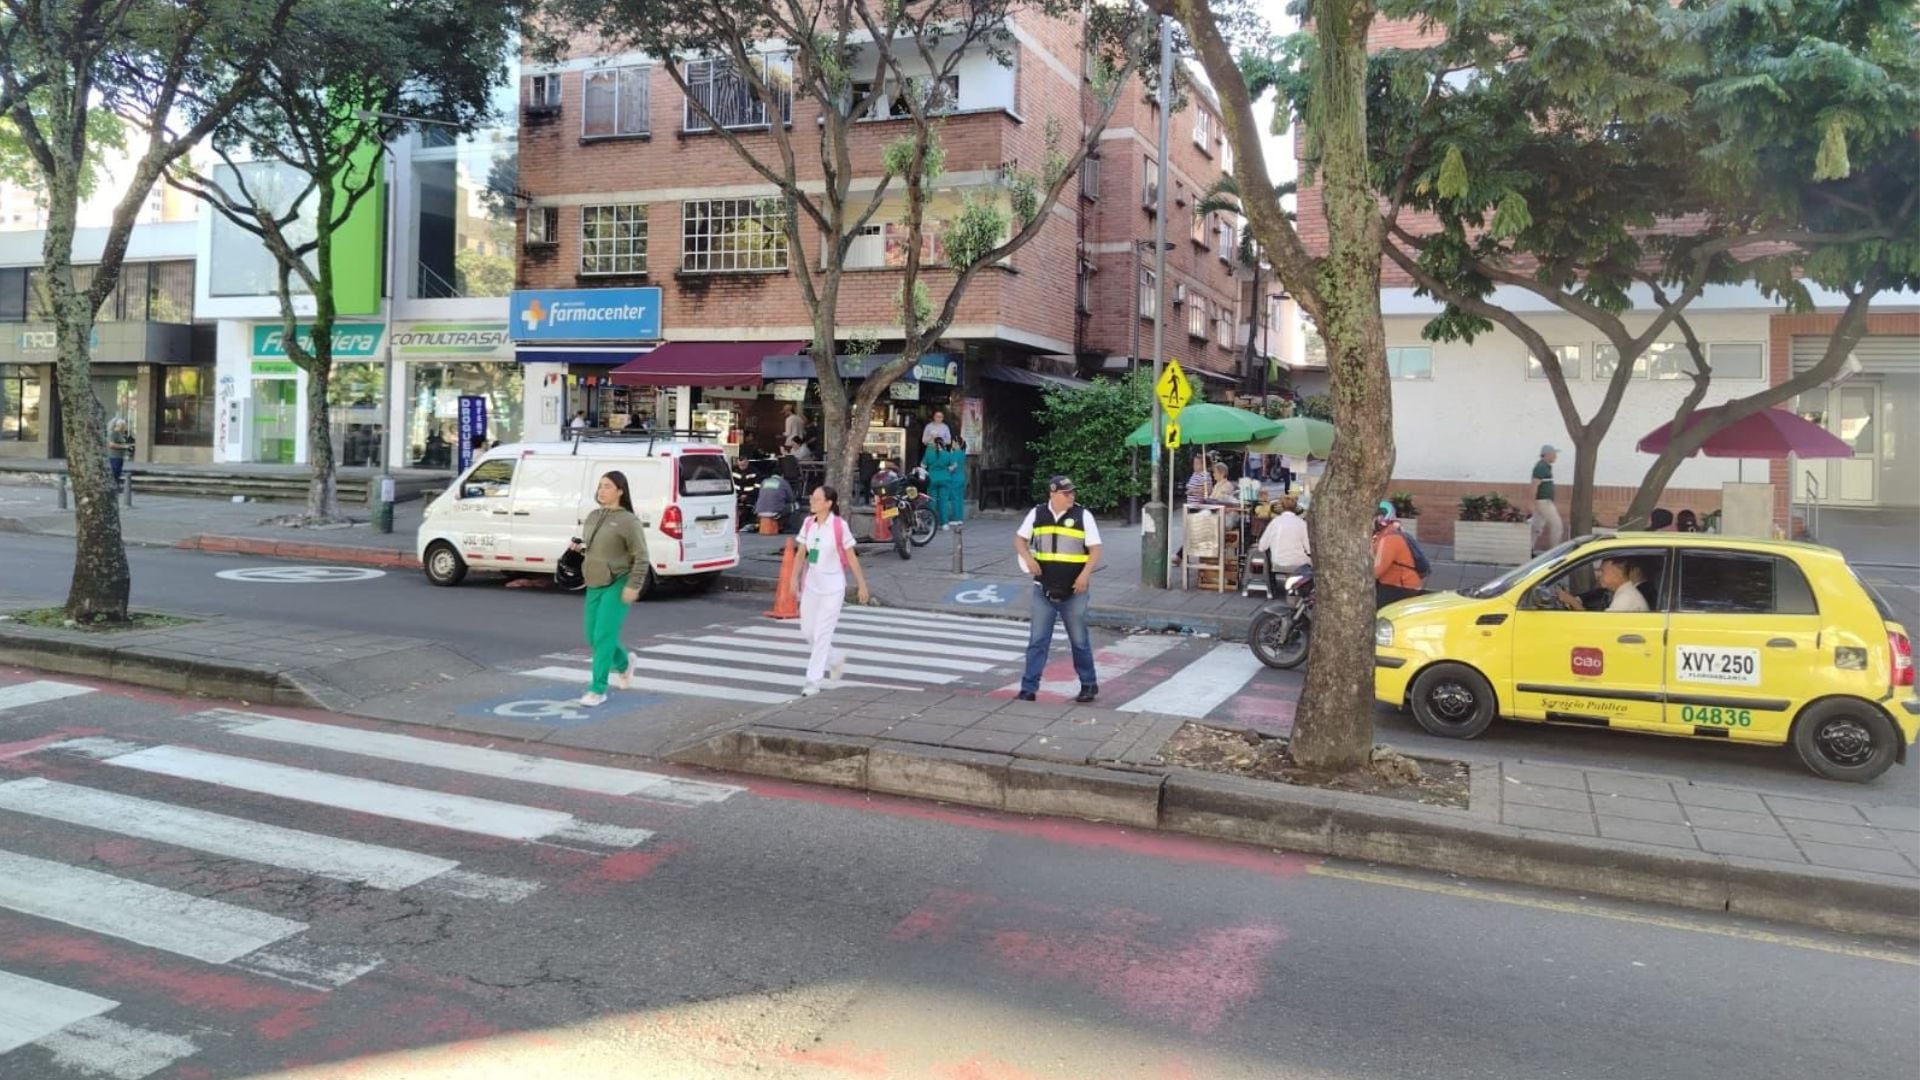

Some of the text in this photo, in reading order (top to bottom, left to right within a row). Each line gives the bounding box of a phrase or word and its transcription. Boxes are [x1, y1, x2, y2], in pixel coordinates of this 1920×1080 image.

[549, 302, 646, 327] farmacenter
[1682, 652, 1754, 674] XVY 250
[1681, 705, 1752, 727] 04836
